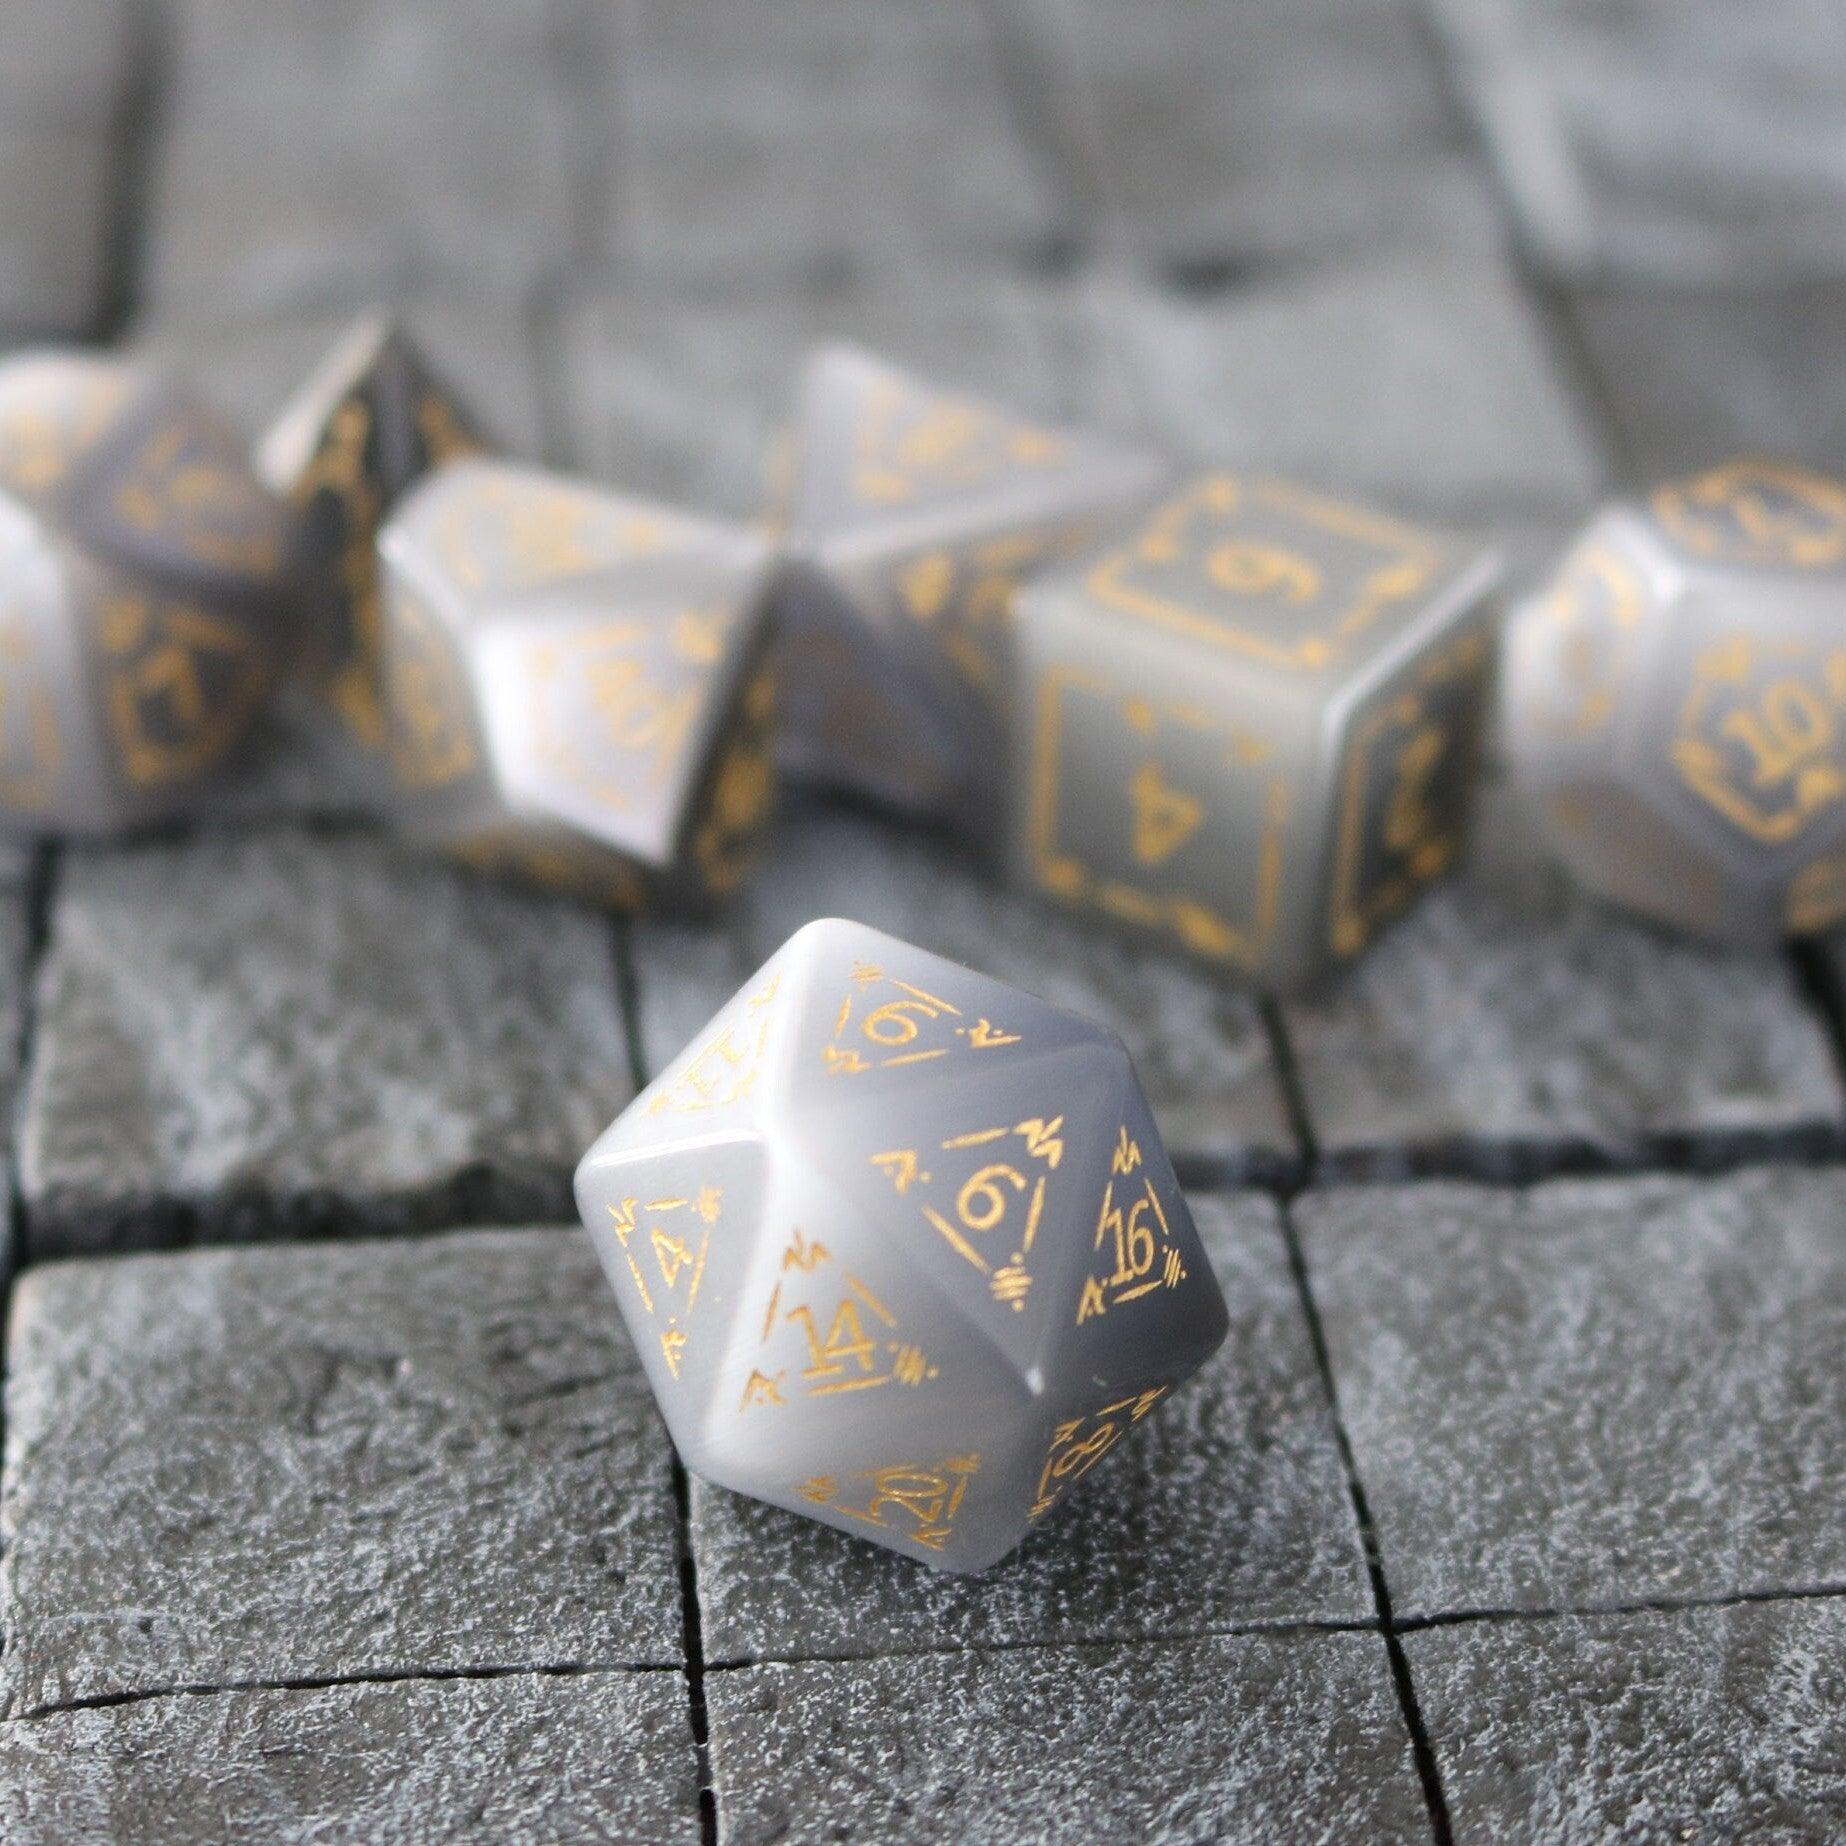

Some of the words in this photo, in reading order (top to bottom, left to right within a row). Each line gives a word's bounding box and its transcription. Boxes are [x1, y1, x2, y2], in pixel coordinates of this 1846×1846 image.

[1720, 678, 1832, 788] 10
[956, 1163, 1028, 1233] 6
[1105, 1198, 1156, 1288] 16
[786, 1299, 877, 1379] 14
[868, 1470, 950, 1523] 20
